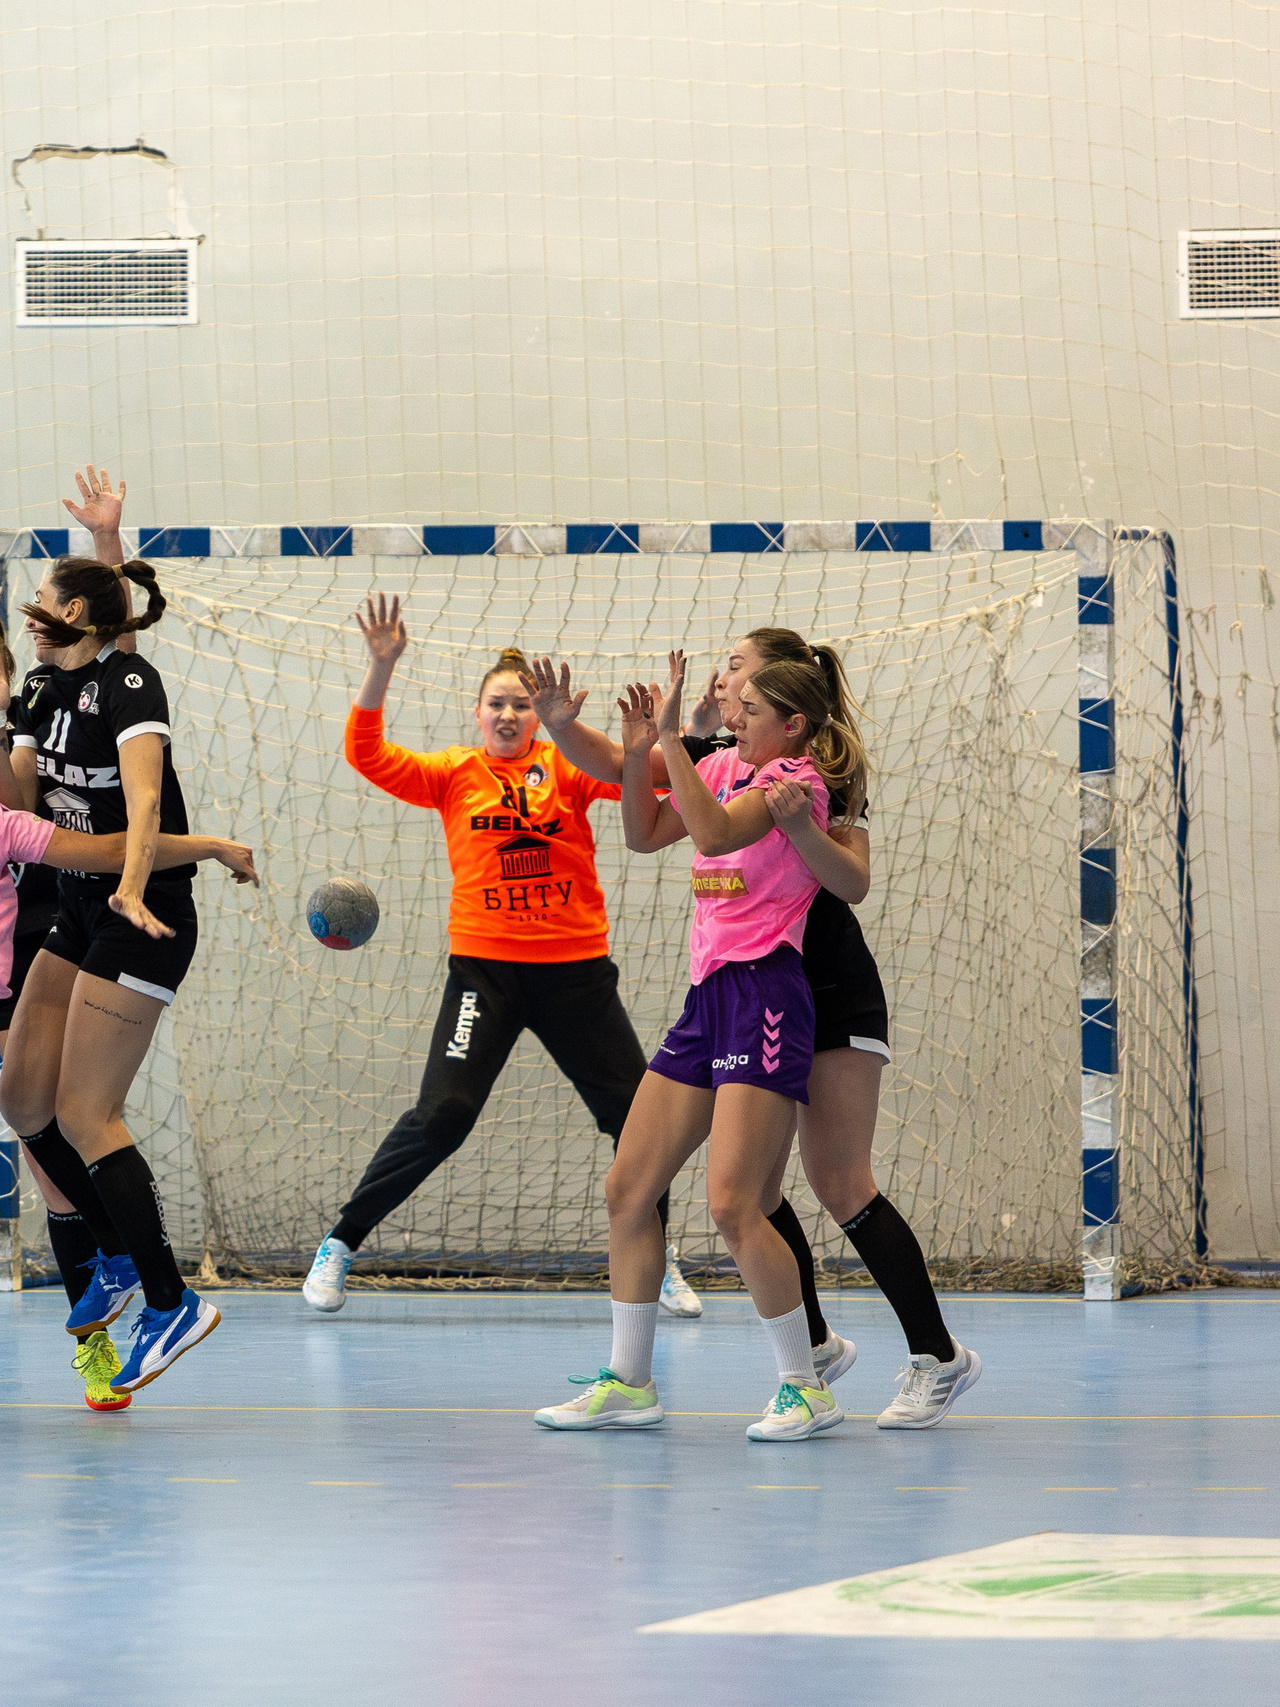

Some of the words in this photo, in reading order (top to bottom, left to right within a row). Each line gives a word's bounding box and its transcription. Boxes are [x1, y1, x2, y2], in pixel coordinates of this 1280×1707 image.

[42, 708, 72, 754] 11
[482, 880, 572, 911] БНТУ
[520, 913, 547, 922] 1920
[446, 991, 481, 1060] Kempa
